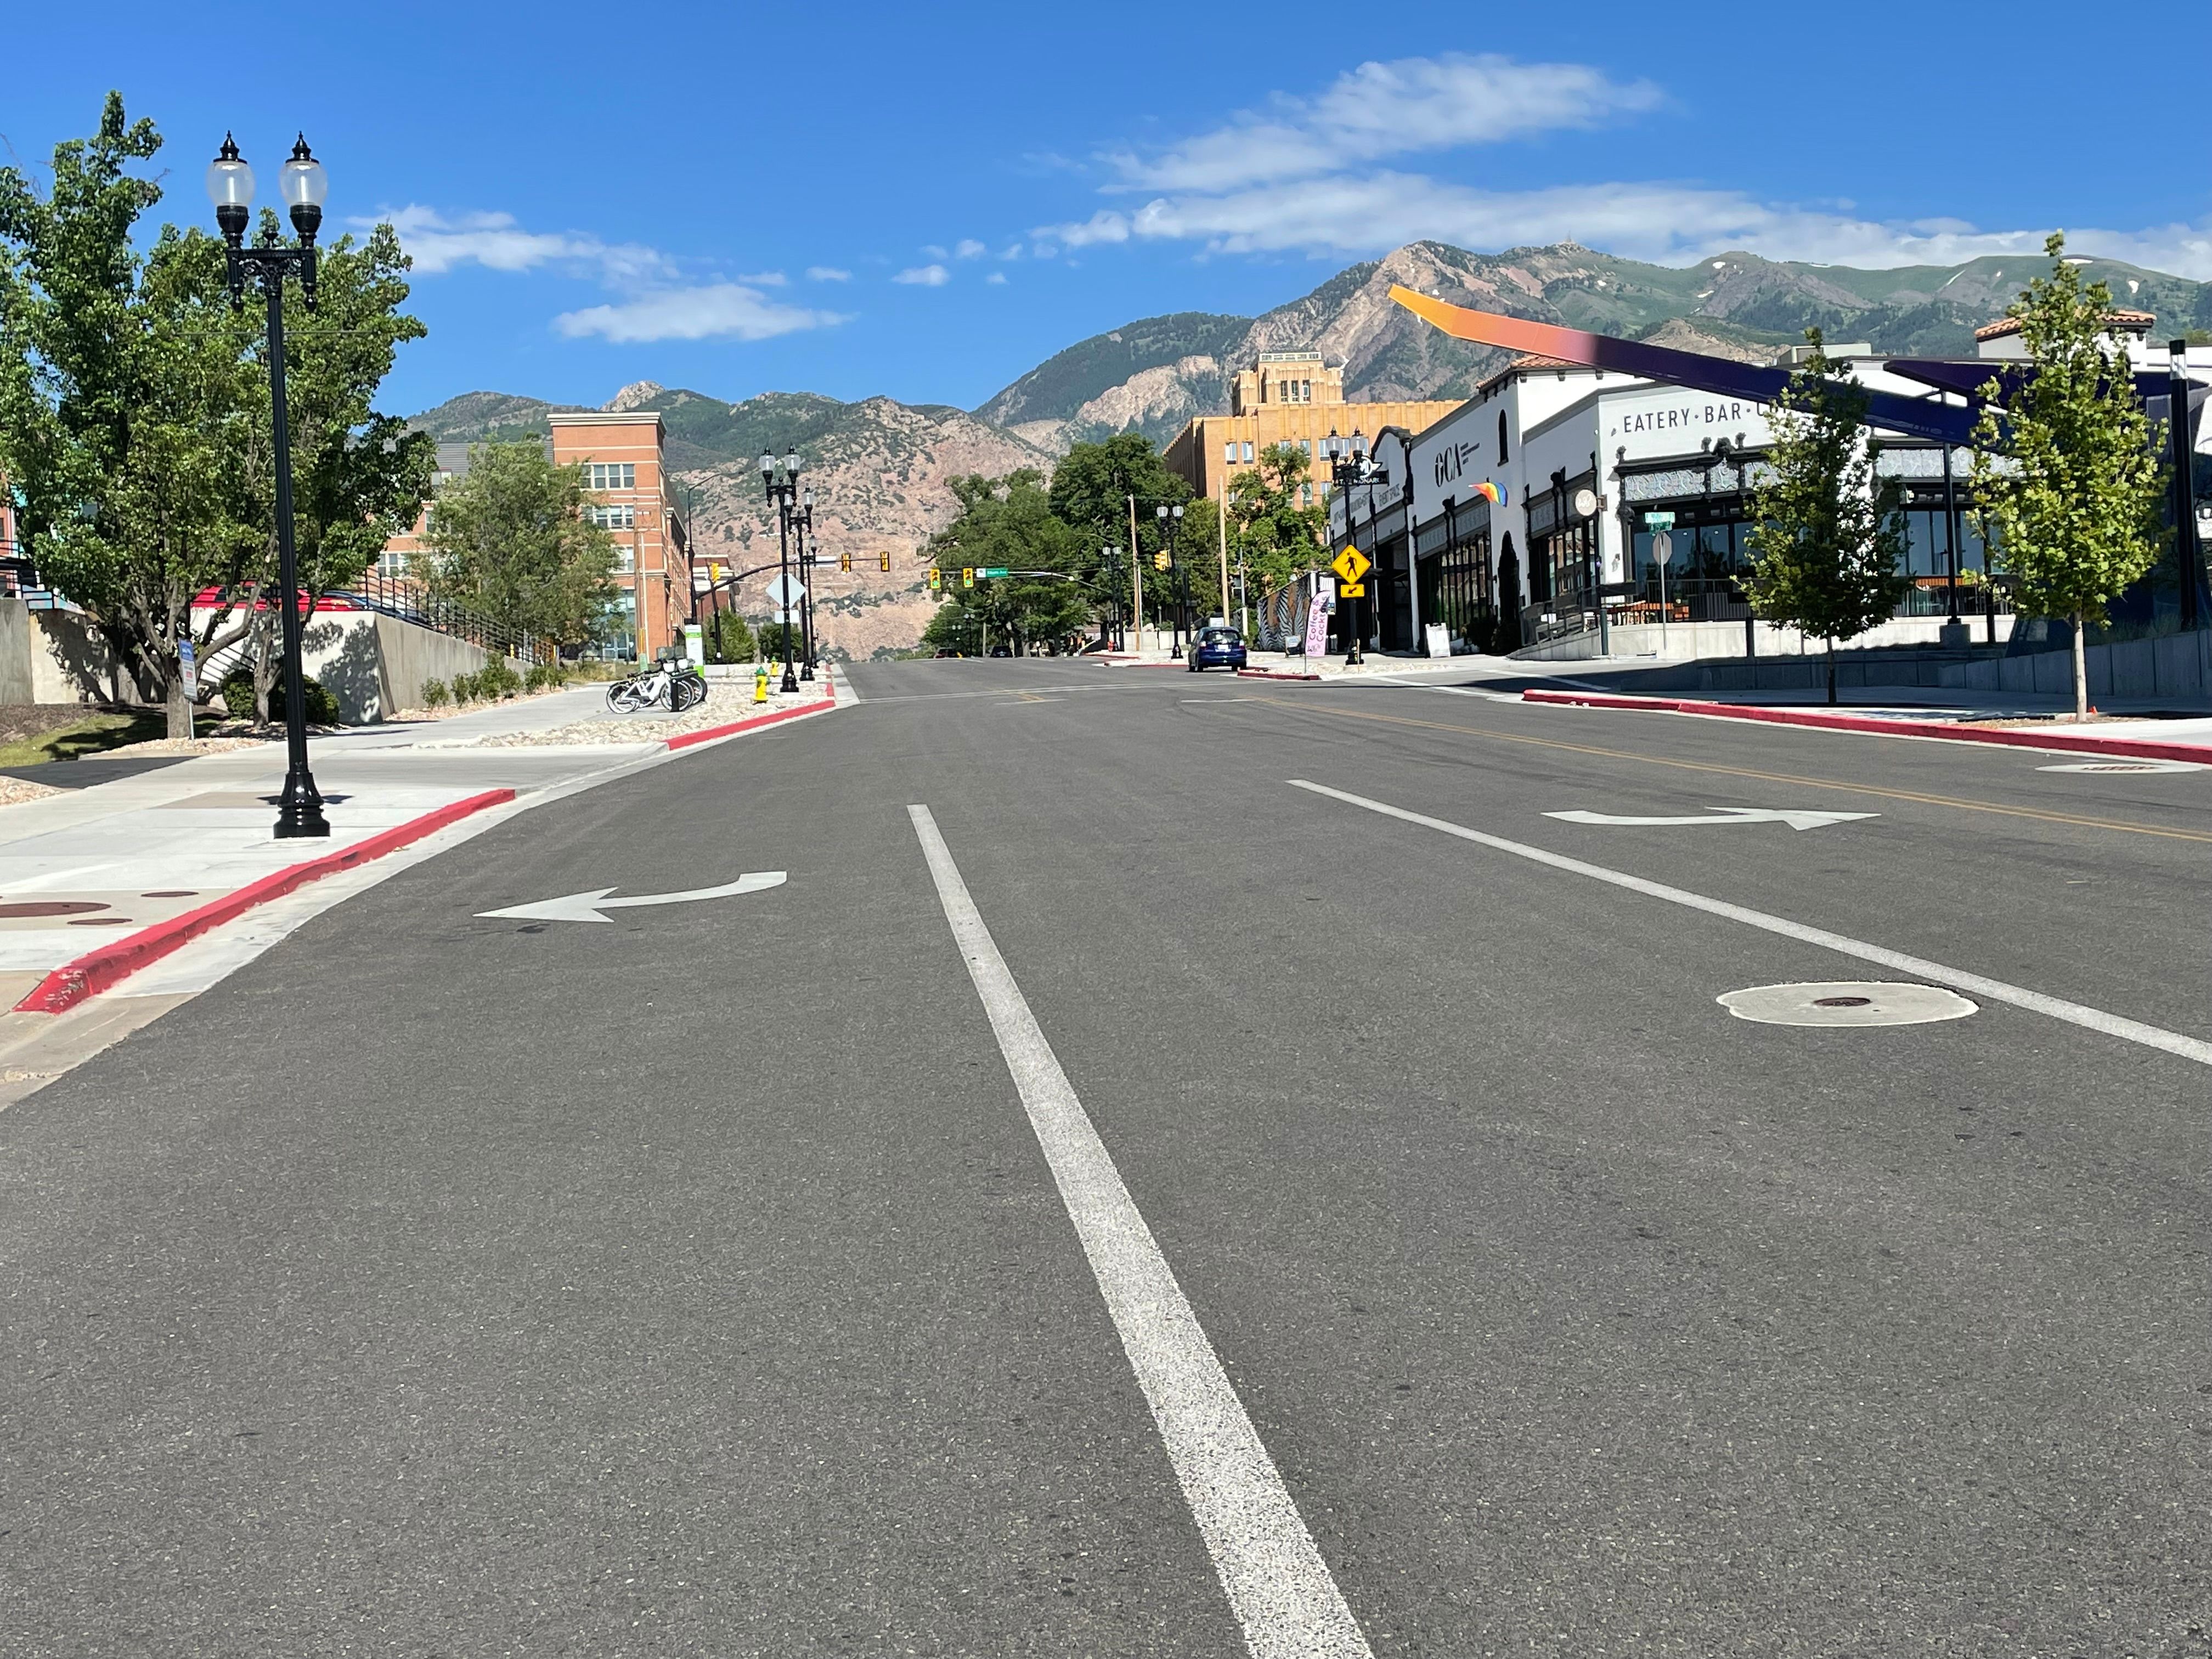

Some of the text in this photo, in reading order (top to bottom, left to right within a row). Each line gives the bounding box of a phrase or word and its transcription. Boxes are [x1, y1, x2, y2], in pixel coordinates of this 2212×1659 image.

[1624, 408, 1690, 433] EATERY
[1705, 402, 1741, 424] BAR
[1435, 442, 1462, 487] OCA
[1309, 609, 1318, 640] Coffee
